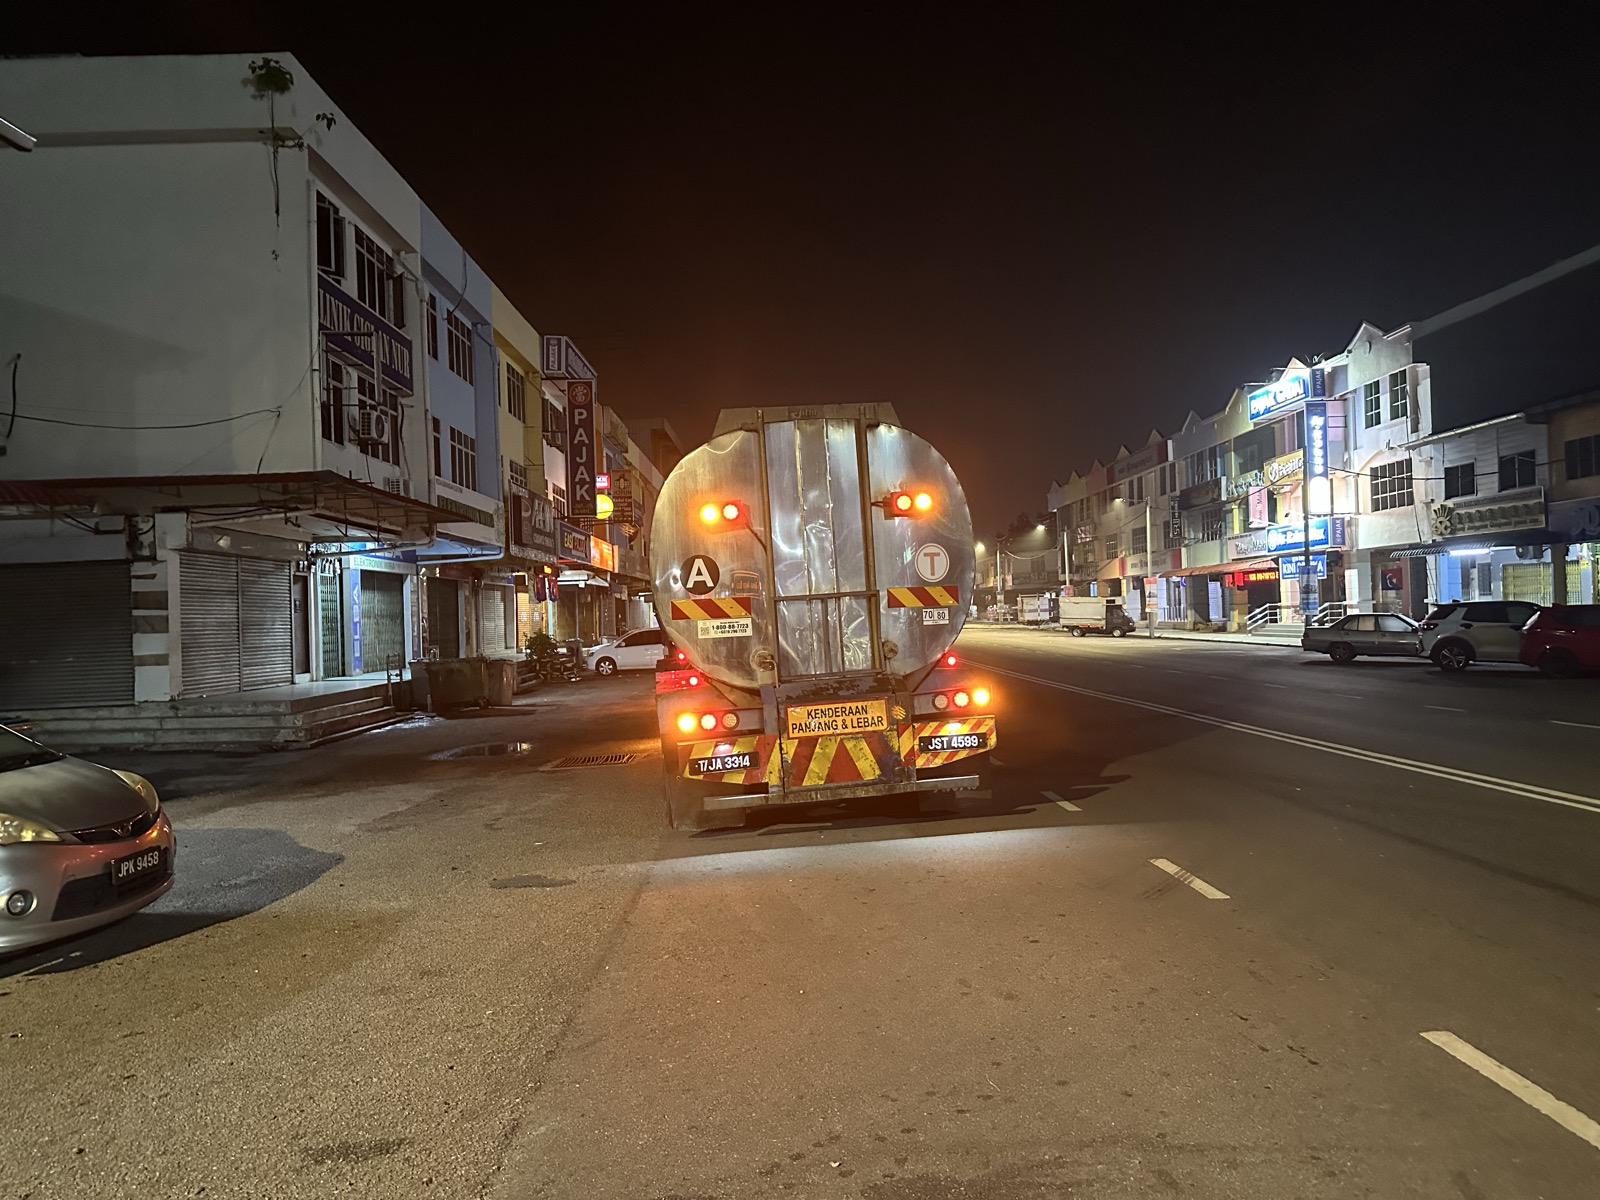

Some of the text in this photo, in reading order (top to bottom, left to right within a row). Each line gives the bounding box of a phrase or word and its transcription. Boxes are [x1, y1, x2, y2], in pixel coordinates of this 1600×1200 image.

[319, 287, 351, 341] LINIK
[391, 338, 410, 379] NUR
[1315, 370, 1323, 389] PAJAK
[573, 408, 591, 500] PAJAK
[1335, 519, 1343, 538] PAJAK
[686, 558, 714, 588] A
[923, 552, 941, 576] T
[1282, 563, 1296, 574] KINI
[923, 610, 933, 619] 70
[806, 704, 868, 720] KENDERAAN
[791, 715, 884, 734] PANJANG & LEBAR
[928, 735, 978, 751] JST 4599
[698, 754, 750, 772] T/JA 3314
[118, 851, 159, 878] JPK 9458
